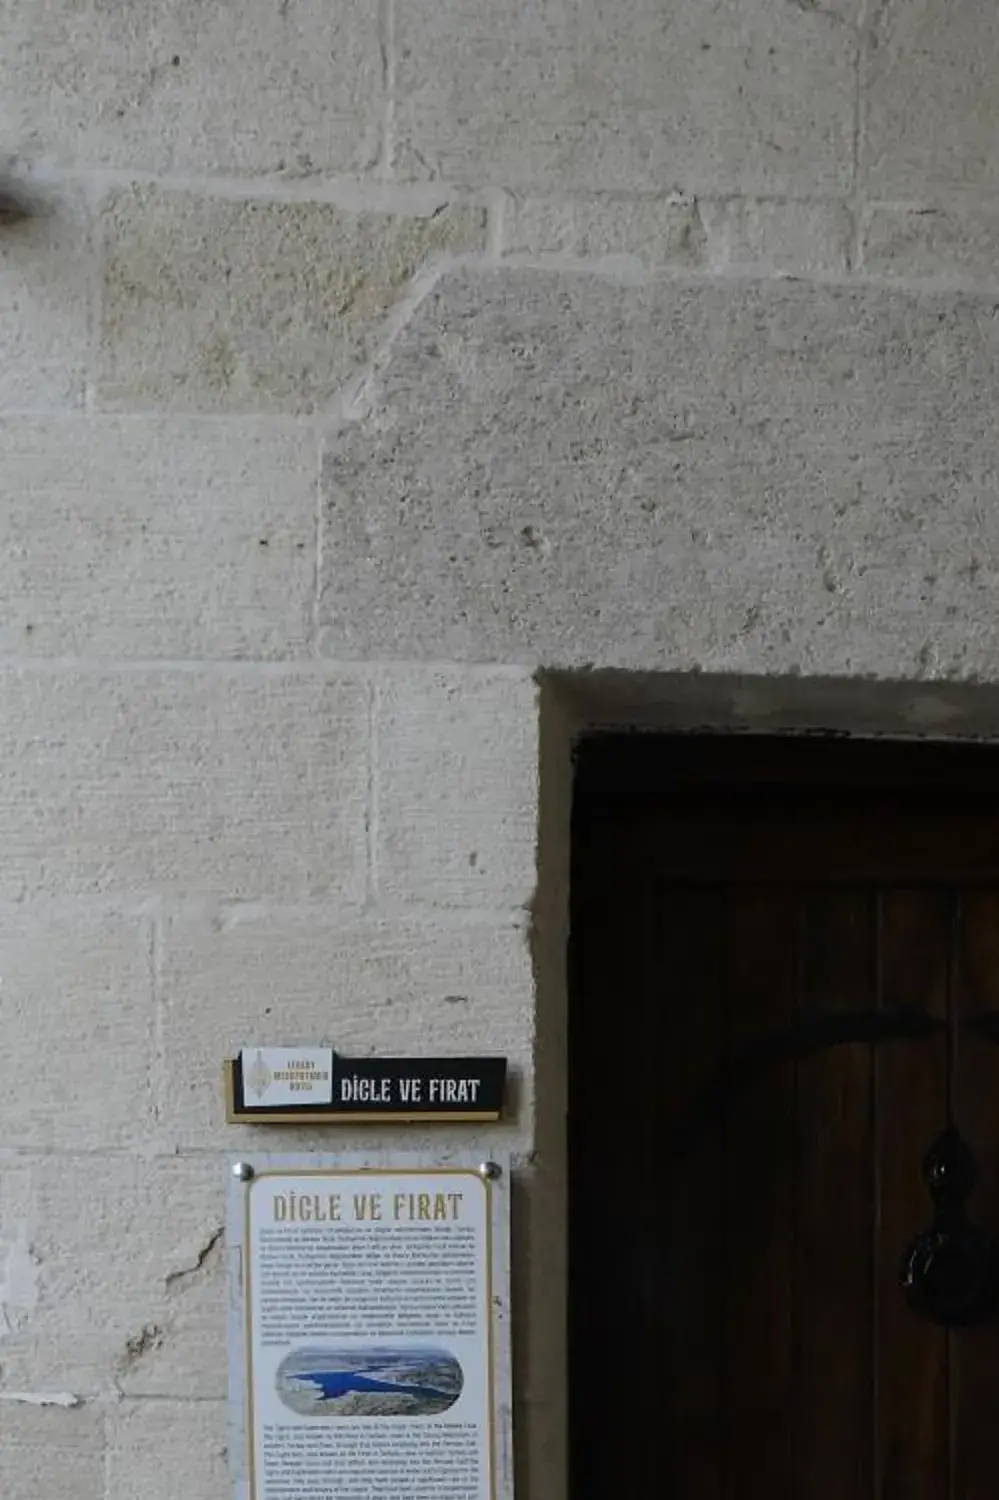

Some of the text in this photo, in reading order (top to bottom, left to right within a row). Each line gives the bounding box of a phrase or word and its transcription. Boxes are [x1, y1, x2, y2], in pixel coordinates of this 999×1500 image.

[341, 1074, 391, 1102] DİCLE
[399, 1079, 421, 1102] VE
[430, 1079, 480, 1102] FIRAT
[353, 1194, 382, 1221] VE
[394, 1193, 463, 1221] FIRAT
